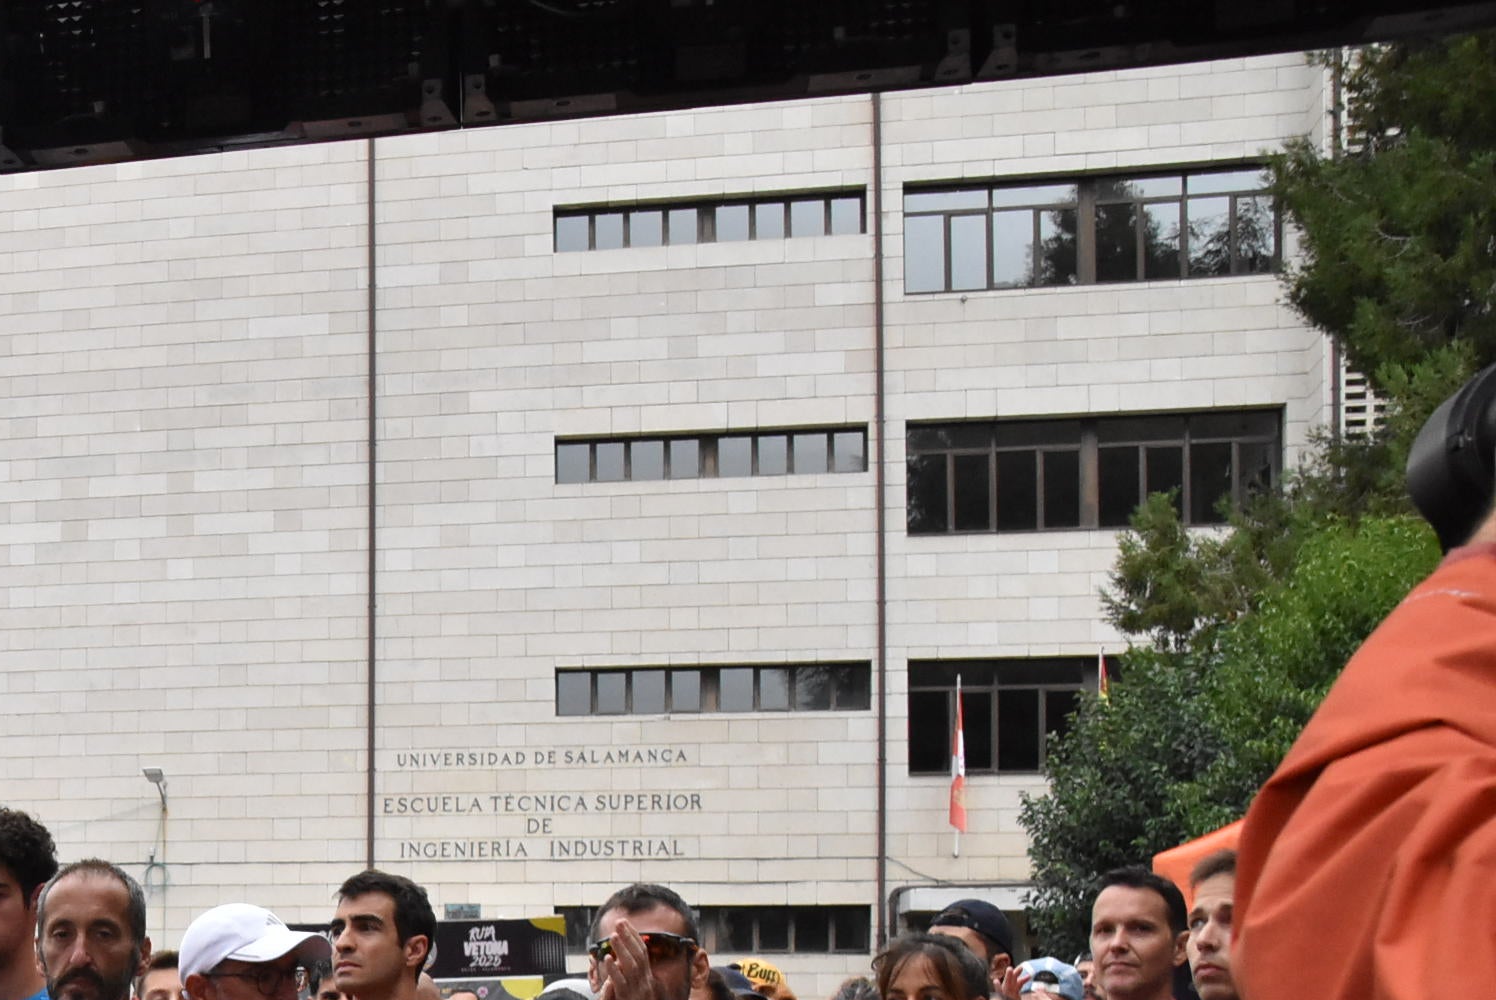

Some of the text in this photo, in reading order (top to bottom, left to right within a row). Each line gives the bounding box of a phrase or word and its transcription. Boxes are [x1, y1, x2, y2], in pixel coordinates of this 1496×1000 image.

[397, 749, 688, 767] UNIVERSIDAD DE SALAMANCA
[383, 794, 702, 814] ESCUELA TÉCNICA SUPERIOR
[527, 818, 553, 834] DE
[400, 839, 684, 858] INGENIERÍA INDUSTRIAL
